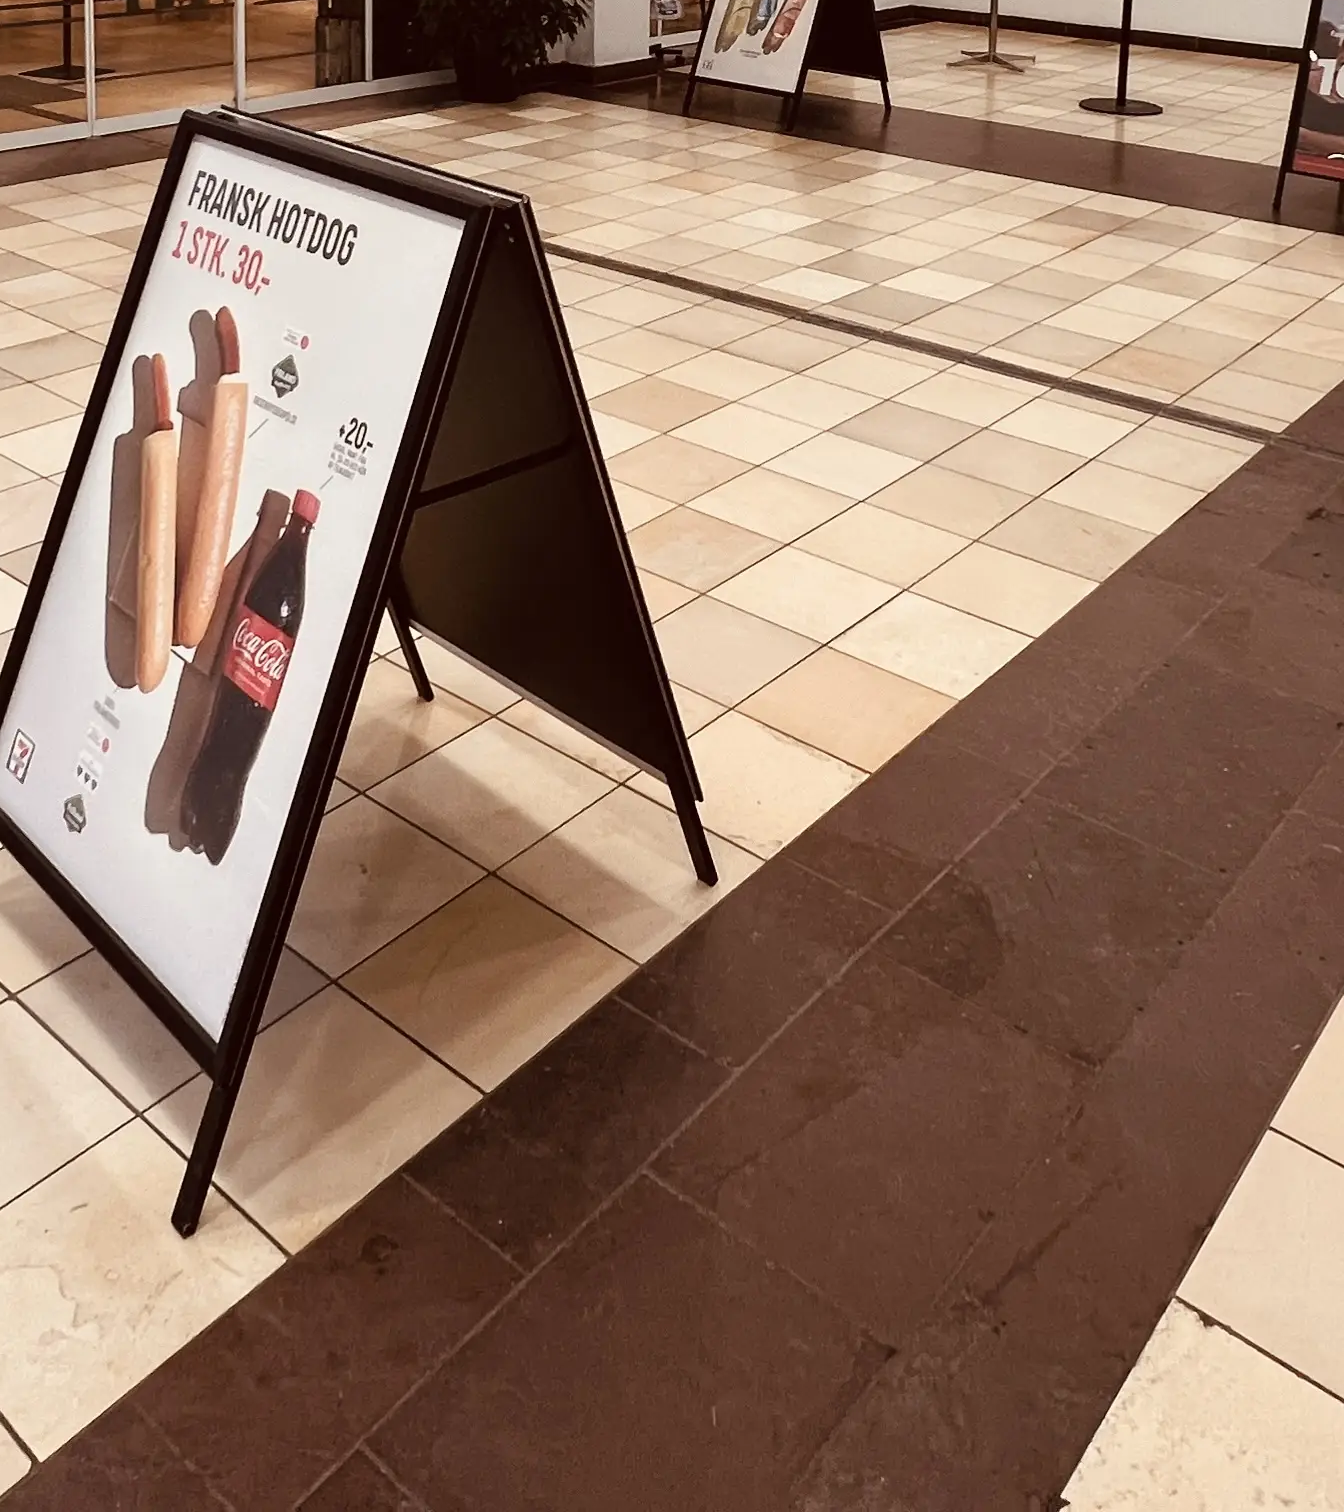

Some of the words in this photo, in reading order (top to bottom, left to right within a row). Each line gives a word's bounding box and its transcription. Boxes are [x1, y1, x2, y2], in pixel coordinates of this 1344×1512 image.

[171, 220, 189, 259] 1
[186, 226, 230, 278] STK.
[232, 244, 271, 296] 30,-
[188, 170, 271, 234] FRANSK
[266, 197, 358, 266] HOTDOG
